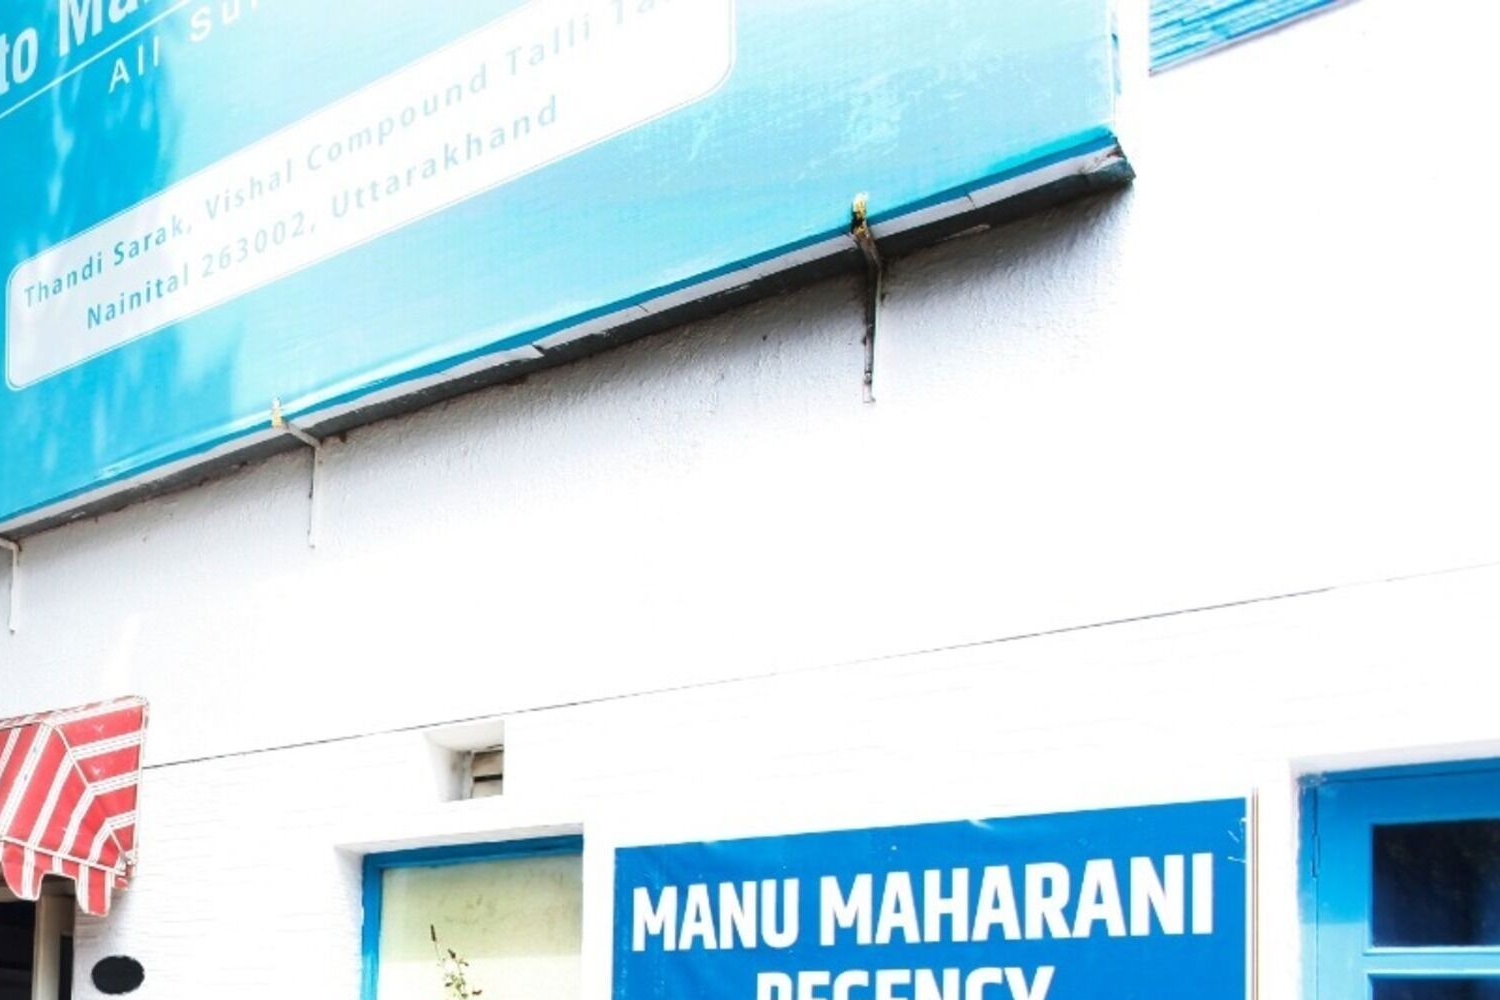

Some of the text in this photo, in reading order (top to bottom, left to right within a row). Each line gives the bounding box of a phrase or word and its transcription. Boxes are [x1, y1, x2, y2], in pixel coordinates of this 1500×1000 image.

[58, 0, 149, 57] Ma
[109, 0, 259, 93] All Su
[25, 250, 103, 309] Thandi
[113, 214, 192, 265] Sarak,
[204, 161, 293, 220] Vishal
[306, 65, 488, 172] Compound
[505, 13, 591, 76] Talli
[87, 95, 557, 329] Nainital 263002, Uttarakhand
[631, 852, 1213, 952] MANU MAHARANI
